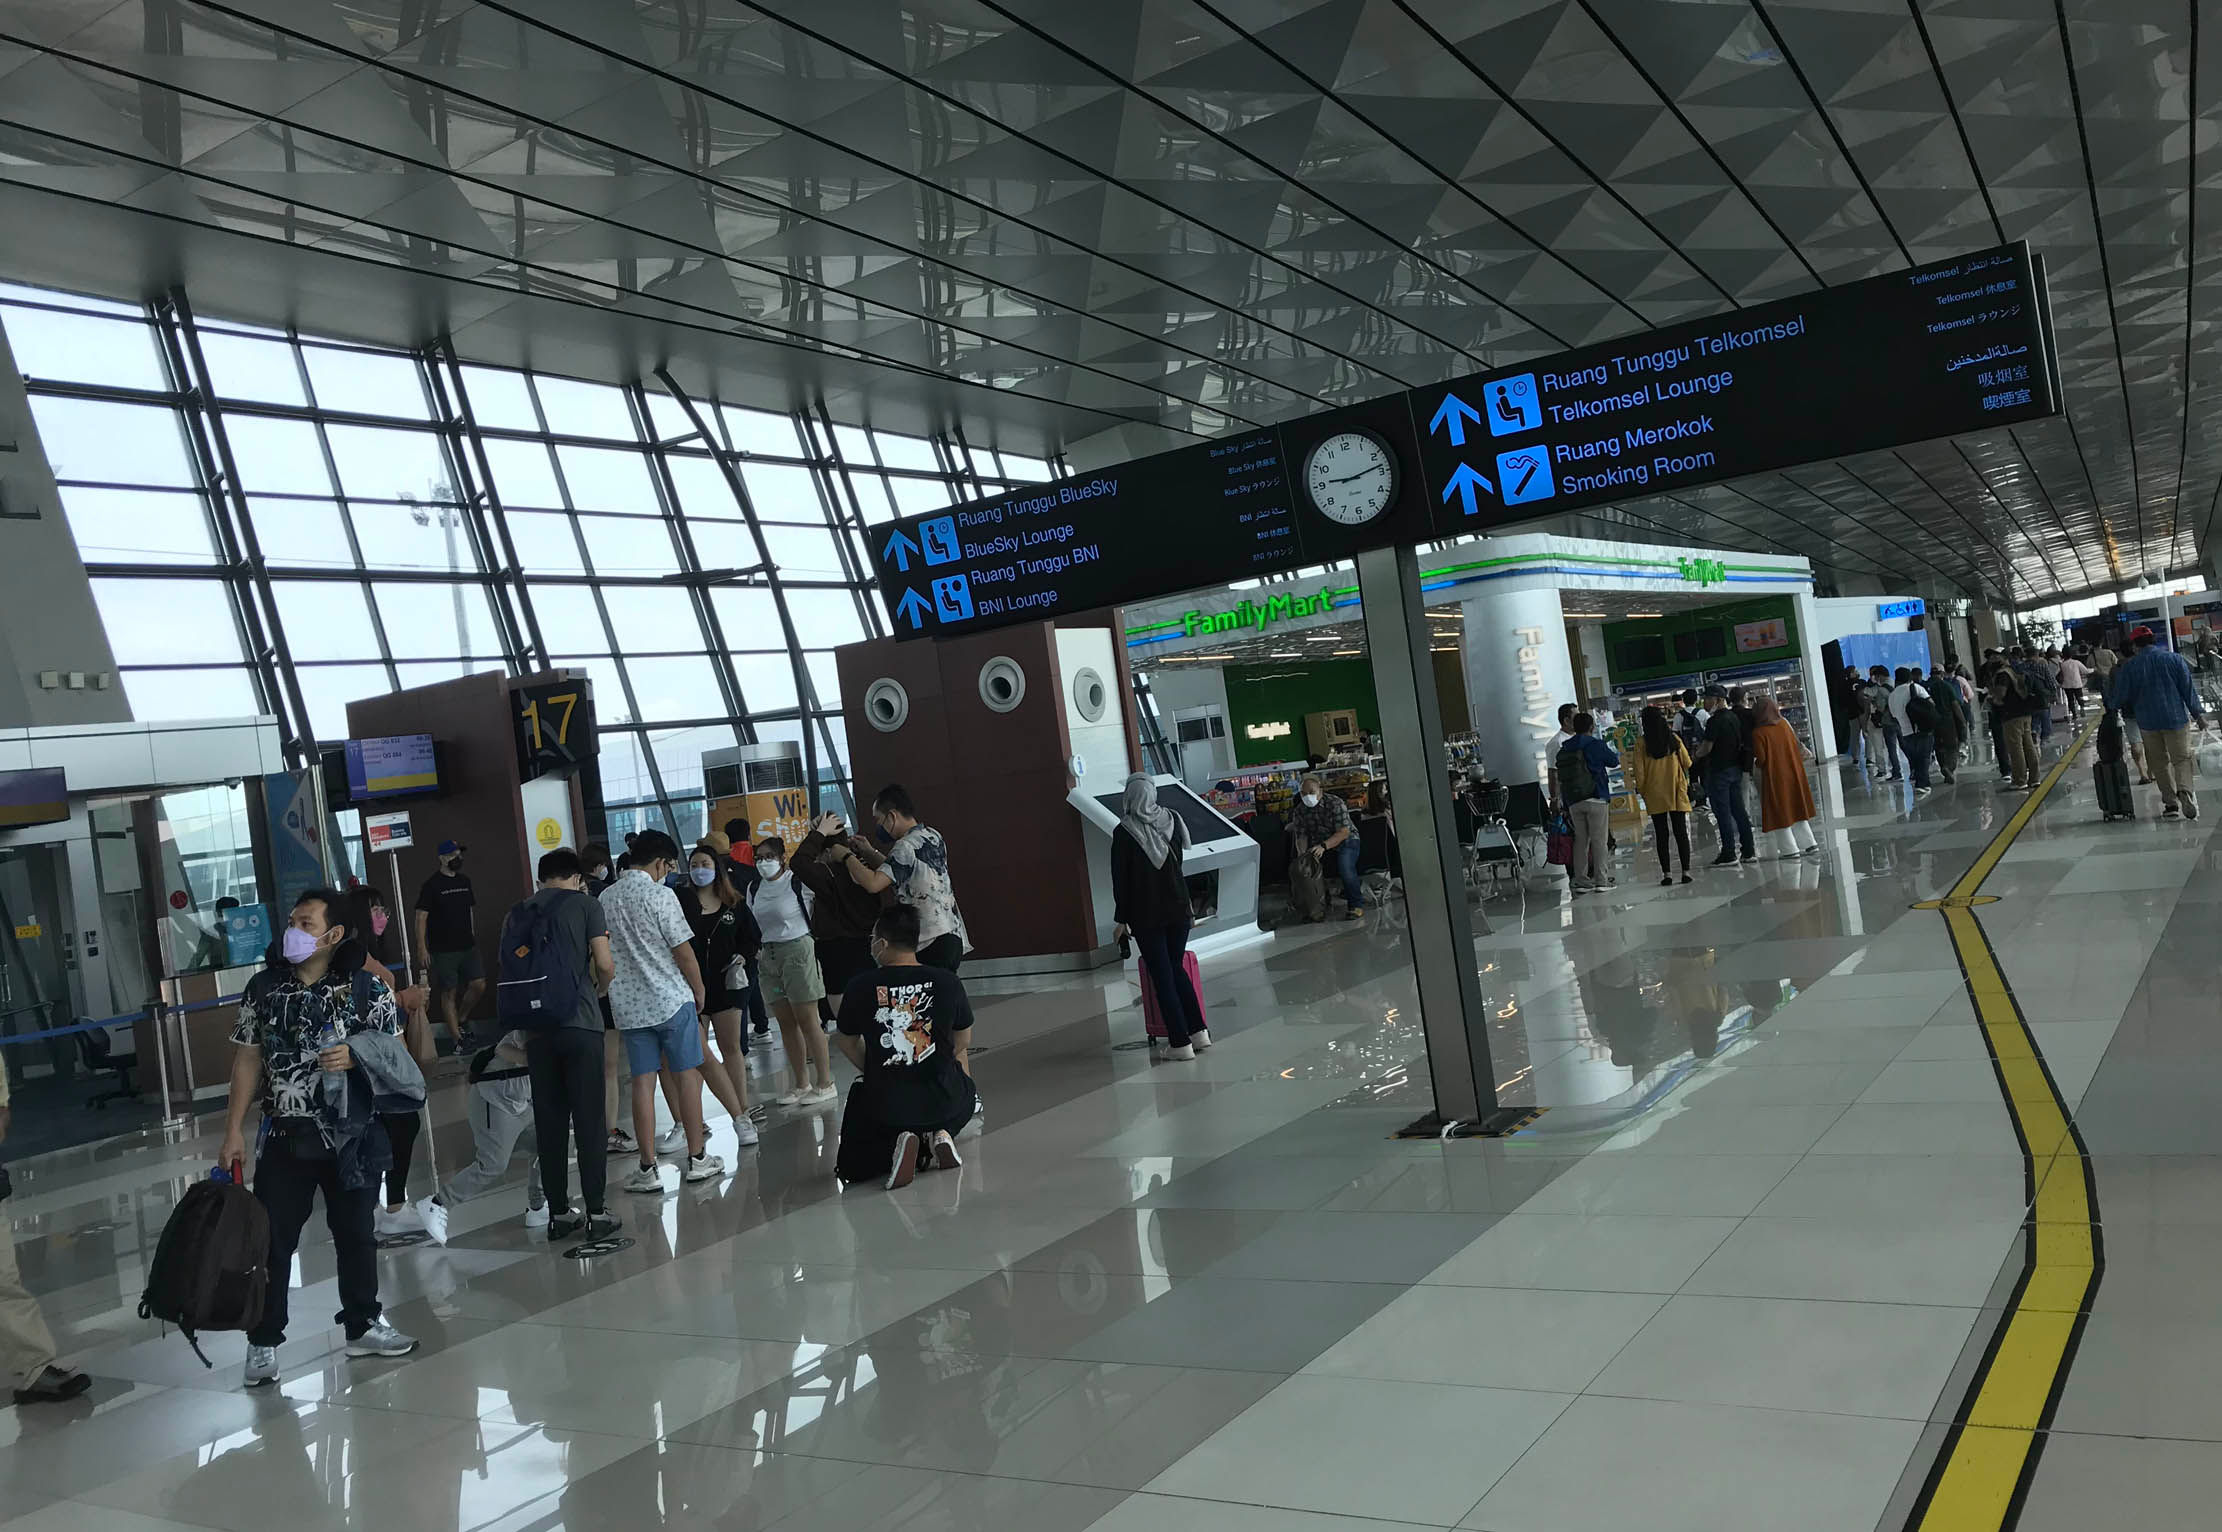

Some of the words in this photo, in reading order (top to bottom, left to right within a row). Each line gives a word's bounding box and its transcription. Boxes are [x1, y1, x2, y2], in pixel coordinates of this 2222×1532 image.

[1908, 266, 1960, 285] Telkomsel
[1936, 288, 1984, 305] Telkomsel
[1927, 315, 1975, 333] Telkomsel
[1978, 304, 2020, 322] ラウンジ
[1543, 365, 1607, 392] Ruang
[1612, 346, 1690, 375] Tunggu
[1694, 315, 1805, 356] Telkomsel
[1978, 365, 2030, 388] 吸烟室
[1548, 385, 1650, 423] Telkomsel
[1656, 371, 1734, 400] Lounge
[1982, 389, 2032, 410] 喫煙室
[1340, 442, 1350, 451] 12
[1556, 437, 1620, 463] Ruang
[1625, 415, 1714, 448] Merokok
[1320, 465, 1329, 474] 10
[1379, 468, 1385, 476] 3
[1563, 465, 1648, 494] Smoking
[1654, 452, 1716, 476] Room
[1319, 482, 1326, 490] 9
[958, 508, 1002, 527] Ruang
[1004, 496, 1056, 516] Tunggu
[1060, 480, 1118, 504] BlueSky
[1327, 497, 1334, 505] 8
[1341, 505, 1347, 514] 7
[1356, 506, 1362, 515] 6
[1368, 499, 1376, 507] 5
[1240, 513, 1252, 522] BNI
[965, 536, 1019, 558] BlueSky
[1022, 524, 1074, 546] Lounge
[971, 566, 1015, 585] Ruang
[1017, 554, 1070, 575] Tunggu
[1072, 544, 1100, 564] BNI
[979, 598, 1003, 616] BNI
[1007, 590, 1058, 610] Lounge
[1184, 586, 1334, 637] FamilyMart
[522, 693, 577, 749] 17
